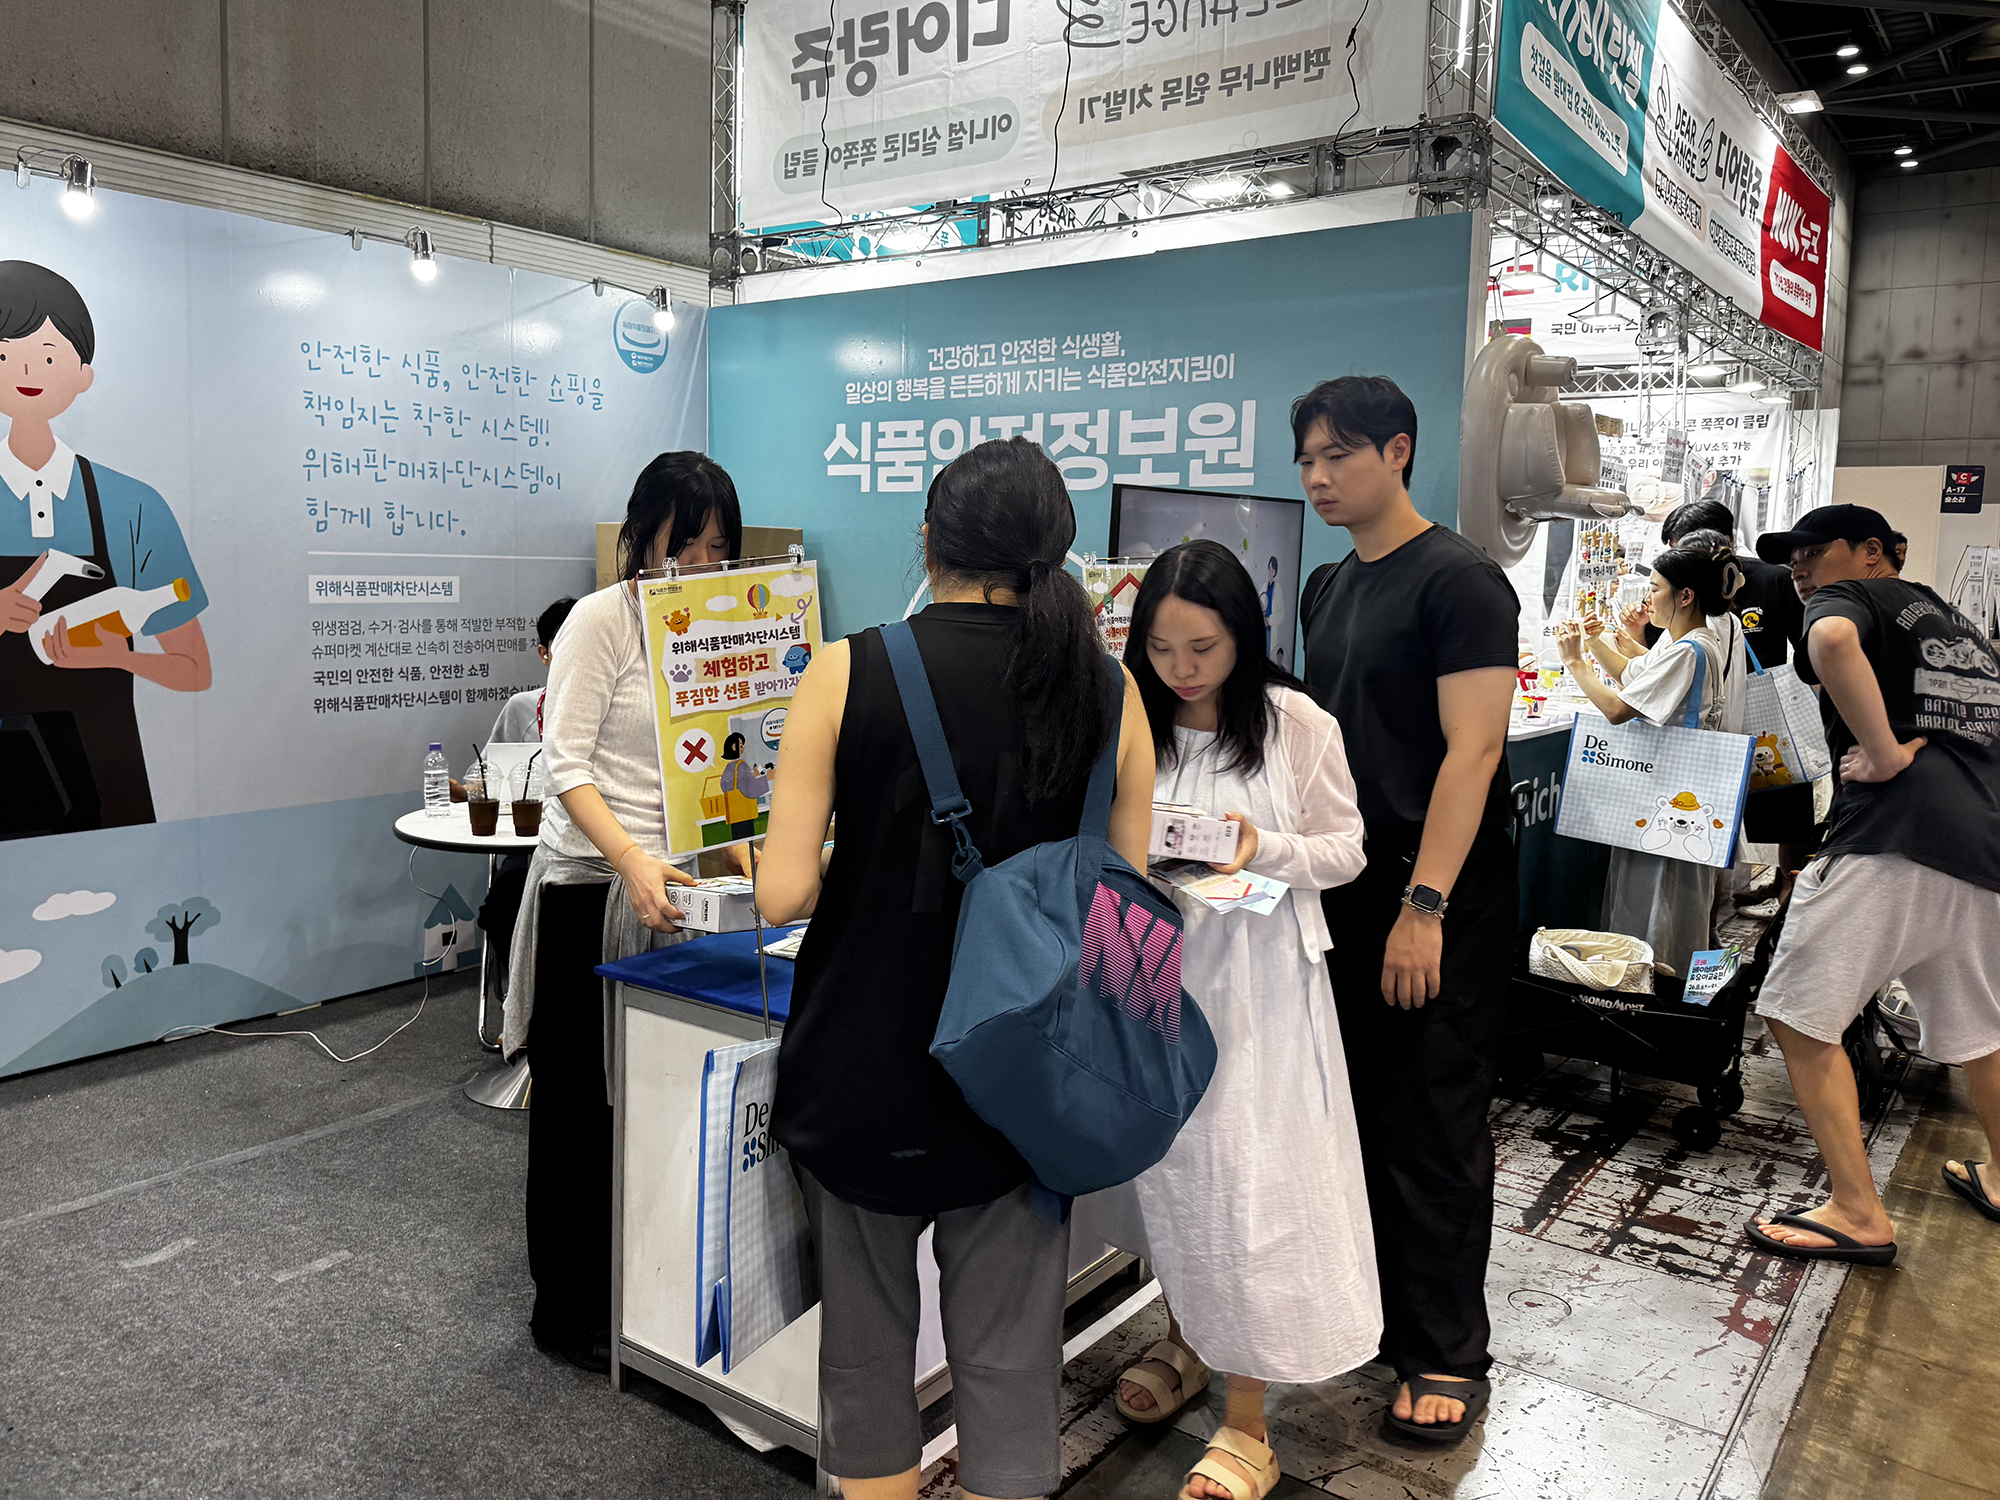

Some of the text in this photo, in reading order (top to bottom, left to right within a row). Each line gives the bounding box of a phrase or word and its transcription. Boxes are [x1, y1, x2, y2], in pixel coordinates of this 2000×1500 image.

[1531, 44, 1552, 89] 첫걸음
[1675, 103, 1697, 147] DEAR
[1715, 131, 1762, 223] 디어랑쥬
[1770, 187, 1803, 256] NUK
[1551, 322, 1576, 335] 국민
[927, 331, 1126, 372] 건강하고 안전한 식생활,
[300, 340, 604, 411] 안전한 식품, 안전한 쇼핑을
[845, 353, 1236, 405] 일상의 행복을 든든하게 지키는 식품안전지킴이
[302, 390, 551, 447] 책임지는 착한 시스템!
[1701, 416, 1739, 431] 쪽쪽이
[1743, 414, 1770, 430] 클립
[302, 448, 563, 494] 위해판매차단시스템이
[306, 497, 466, 537] 함께 합니다.
[315, 580, 453, 597] 위해식품판매차단시스템
[311, 620, 366, 637] 위생점검,
[435, 617, 458, 633] 통해
[460, 617, 493, 632] 적발한
[495, 617, 526, 631] 부적합
[671, 624, 801, 655] 위해식품판매차단시스템
[311, 642, 362, 660] 슈퍼마켓
[364, 641, 413, 658] 계산대로
[415, 640, 450, 656] 신속히
[452, 638, 495, 655] 전송하여
[496, 637, 527, 652] 판매를
[313, 662, 490, 686] 국민의 안전한 식품, 안전한 쇼핑
[703, 652, 770, 679] 체험하고
[313, 689, 462, 714] 위해식품판매차단시스템이
[675, 682, 719, 708] 푸짐한
[723, 680, 751, 701] 선물
[1584, 734, 1608, 751] De
[1595, 751, 1653, 774] Simone
[744, 1102, 769, 1138] De
